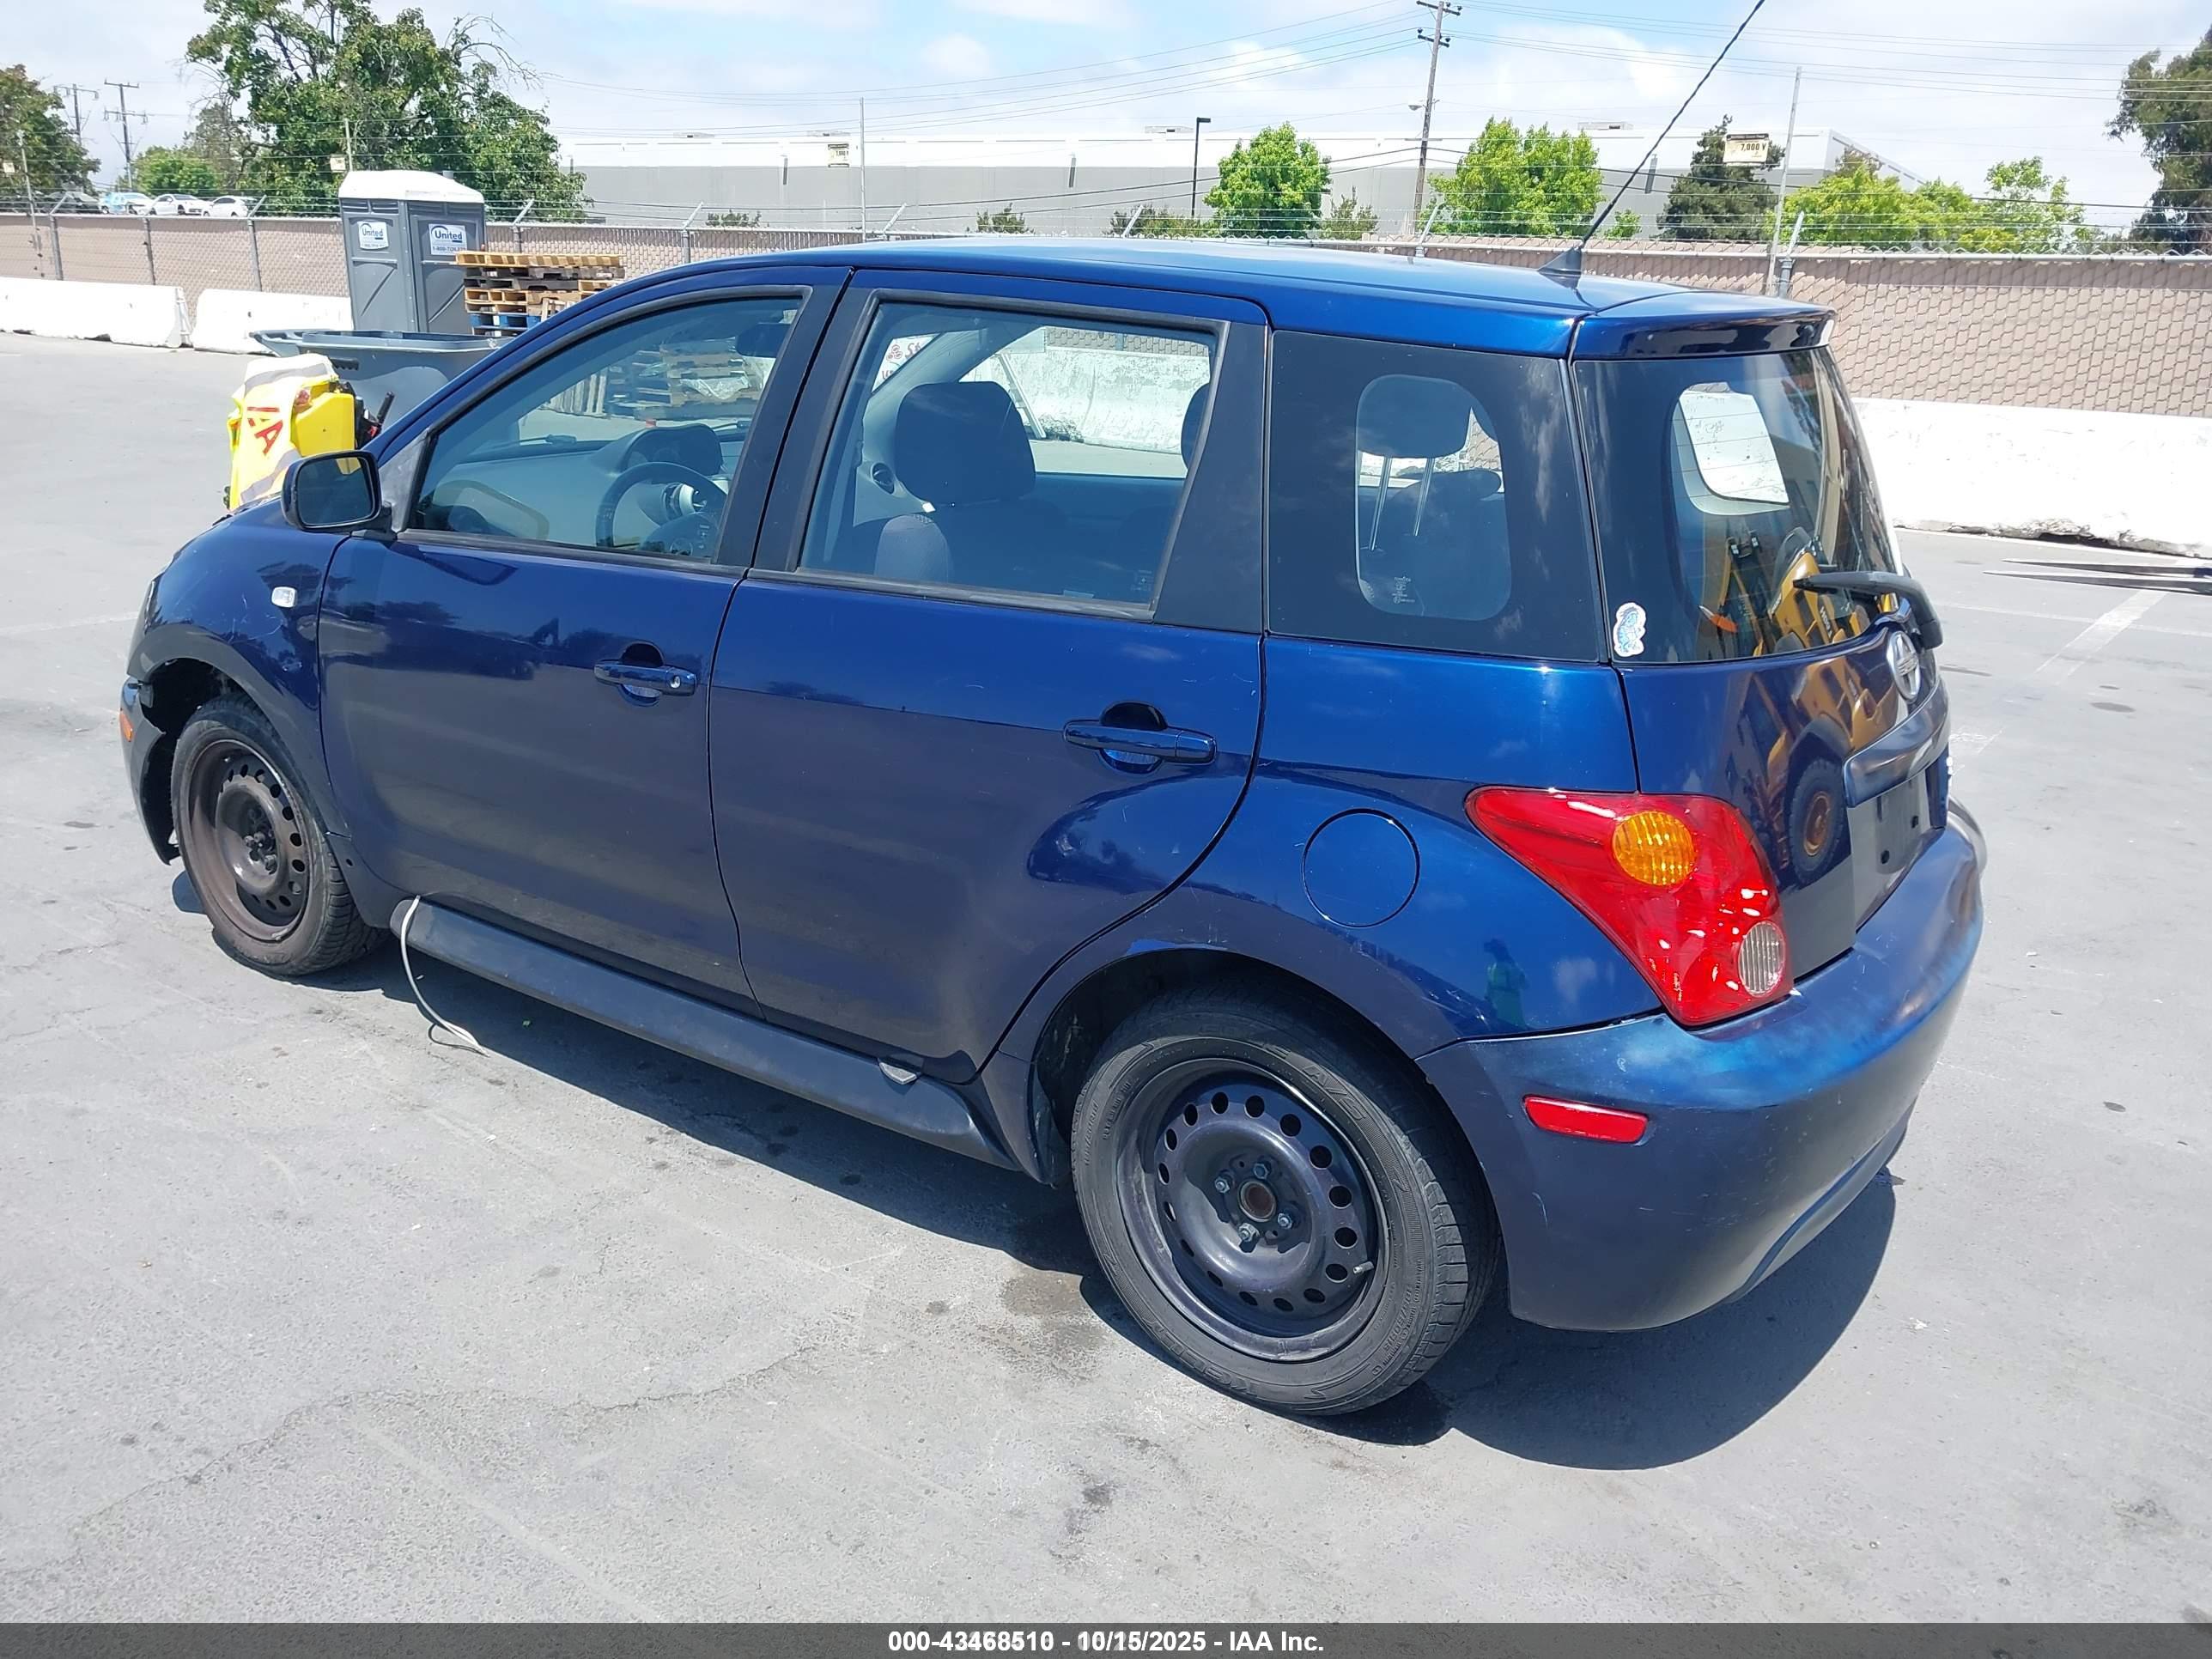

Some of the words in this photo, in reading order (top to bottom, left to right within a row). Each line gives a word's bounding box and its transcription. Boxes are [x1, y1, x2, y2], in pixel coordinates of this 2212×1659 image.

[1741, 143, 1760, 152] 7,000
[362, 228, 384, 237] United
[434, 230, 463, 240] United
